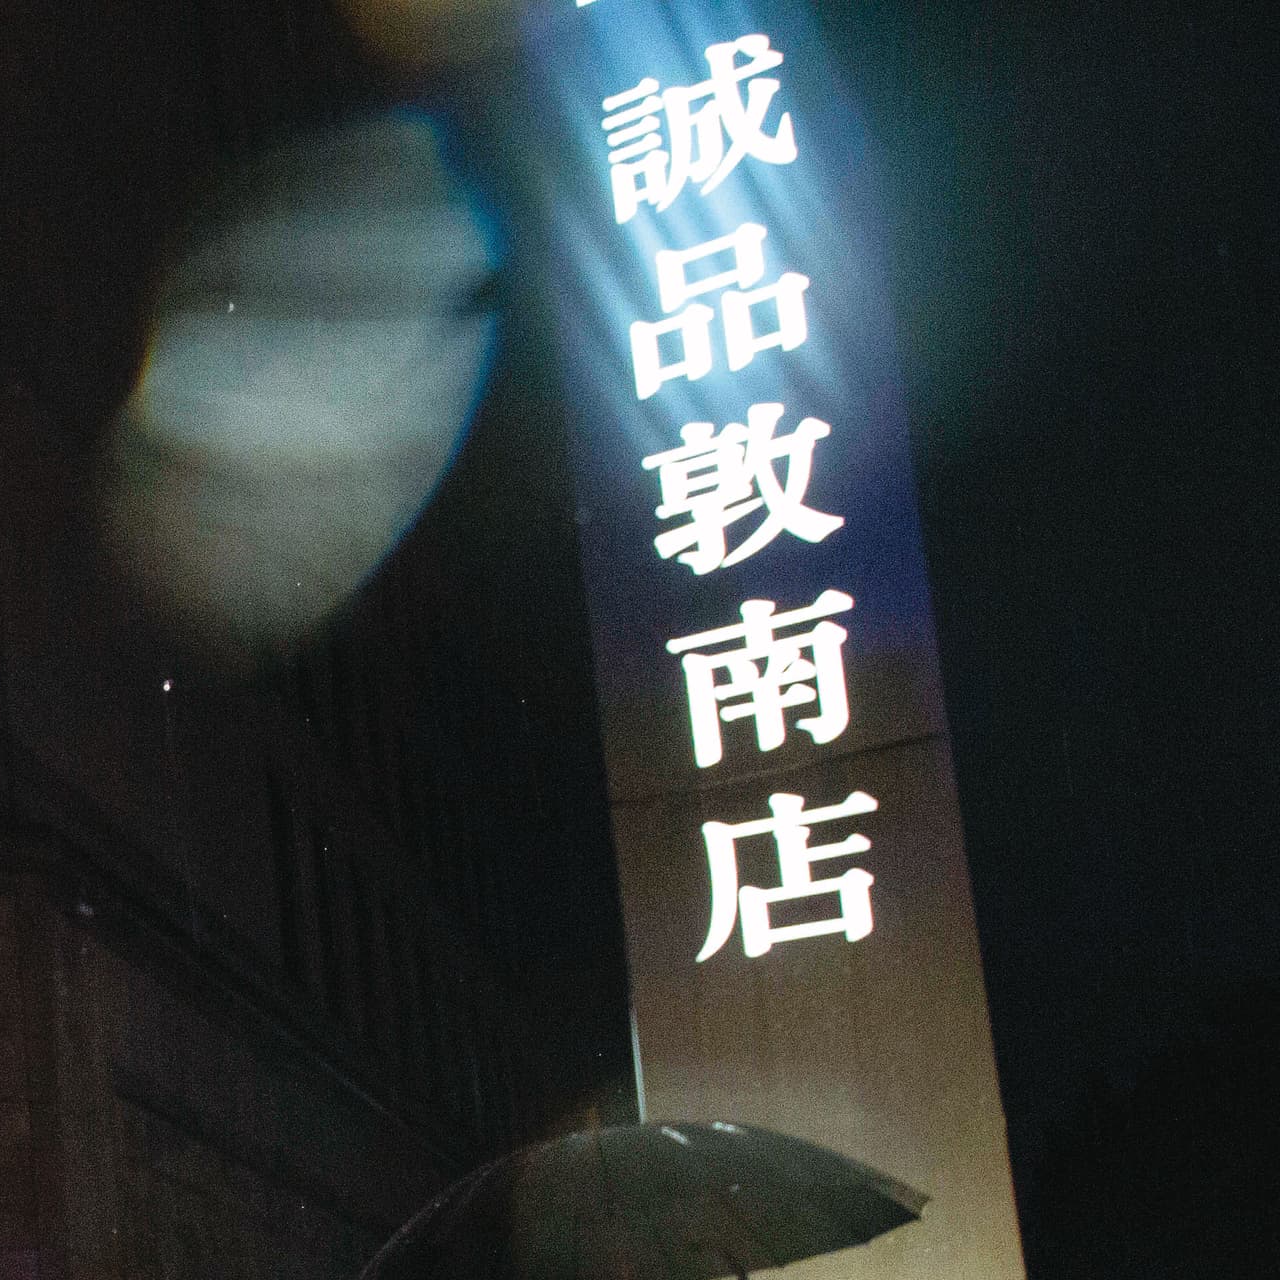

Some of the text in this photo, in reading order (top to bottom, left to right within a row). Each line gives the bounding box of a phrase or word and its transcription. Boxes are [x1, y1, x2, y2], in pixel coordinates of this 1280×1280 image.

[601, 33, 879, 964] 誠品敦南店
